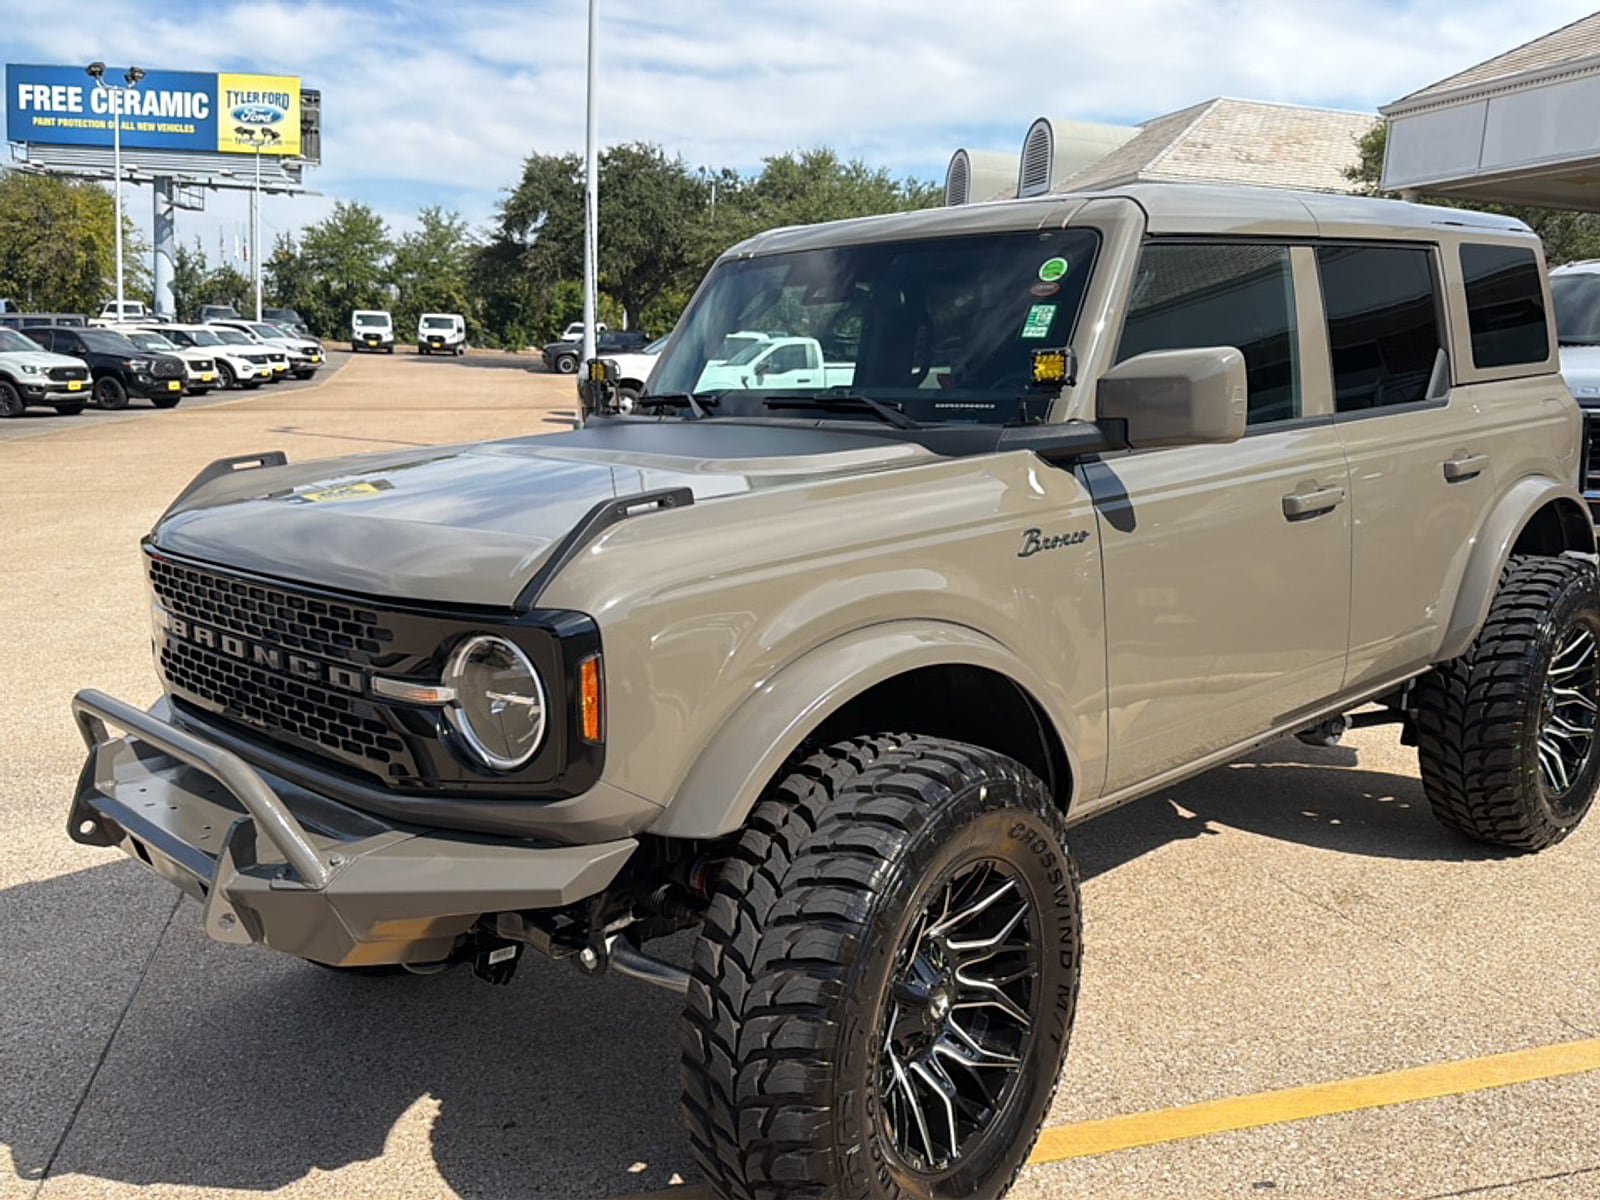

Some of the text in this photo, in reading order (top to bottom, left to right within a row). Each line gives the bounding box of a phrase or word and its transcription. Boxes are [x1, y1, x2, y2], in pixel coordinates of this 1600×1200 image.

[18, 84, 209, 119] FREE CERAMIC
[225, 90, 289, 110] TYLER FORD
[57, 118, 106, 129] PROTECTION
[157, 123, 195, 133] VEHICLES
[241, 108, 273, 123] Ford
[1018, 528, 1090, 557] Bronco
[172, 617, 362, 693] BRONCO
[1008, 823, 1073, 970] CROSSWIND
